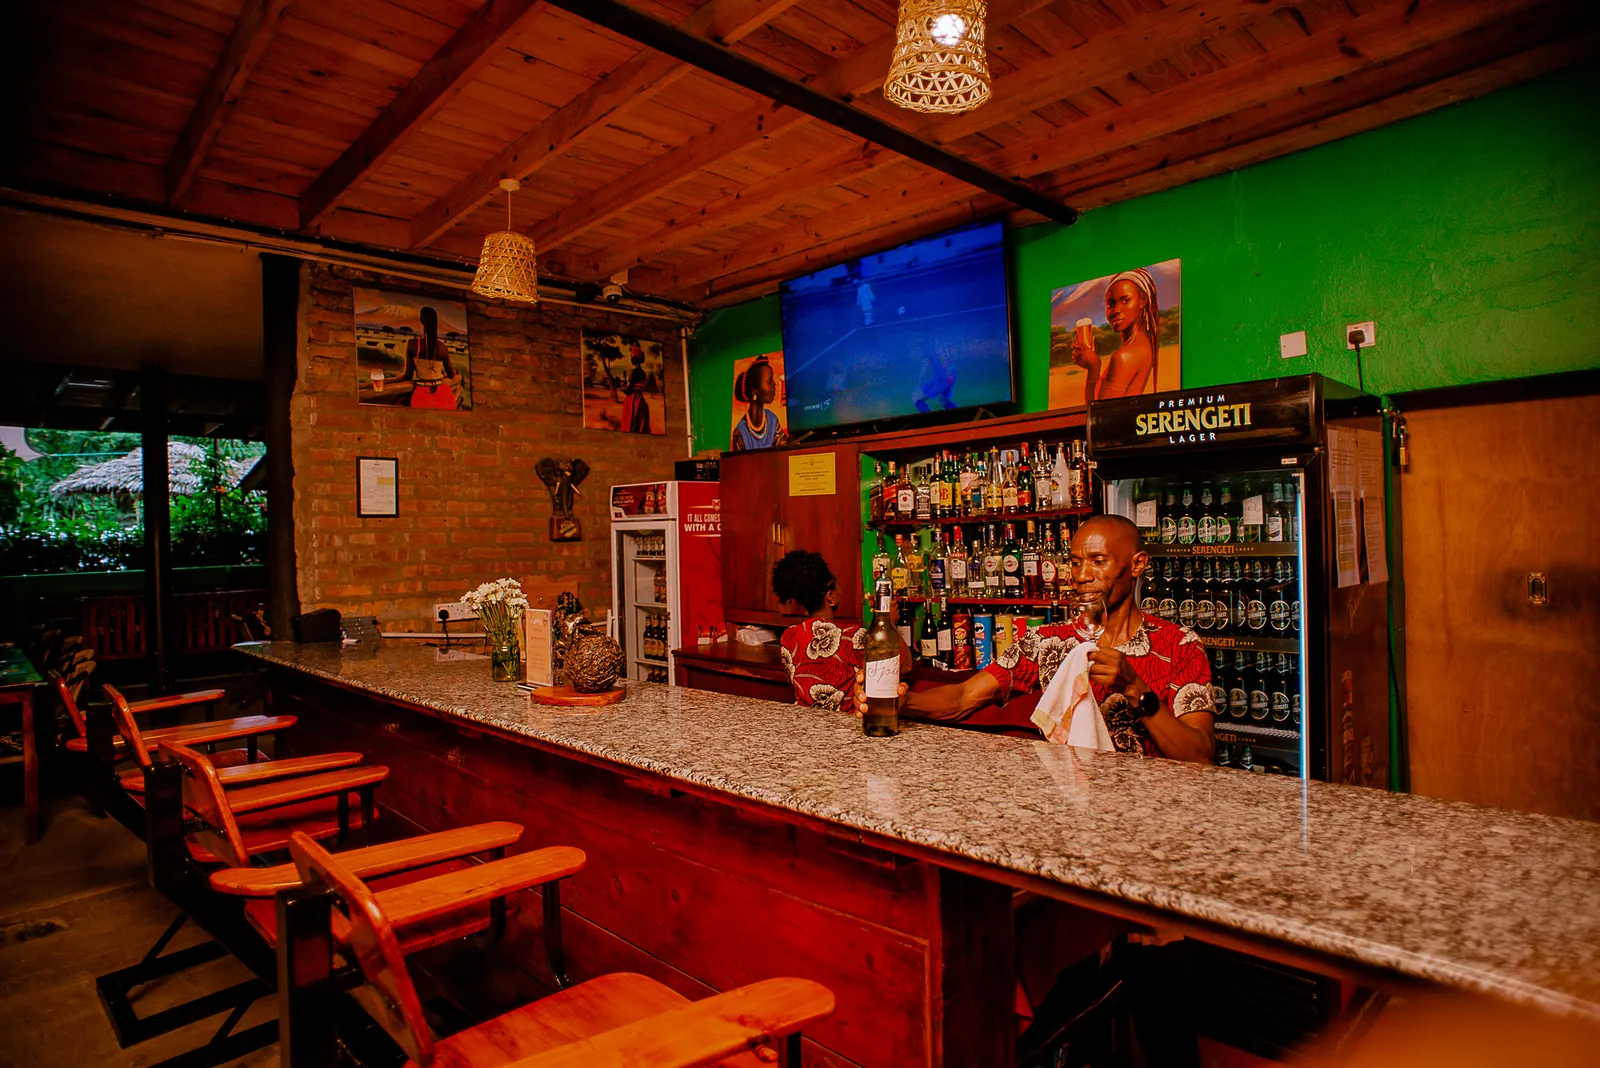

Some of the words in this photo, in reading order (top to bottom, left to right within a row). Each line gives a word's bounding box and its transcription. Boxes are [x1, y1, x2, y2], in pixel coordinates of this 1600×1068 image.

[1158, 395, 1225, 409] PREMIUM
[1135, 402, 1252, 436] SERENGETI
[1169, 432, 1217, 444] LAGER
[687, 514, 693, 523] IT
[694, 514, 703, 523] ALL
[684, 524, 706, 532] WITH
[708, 523, 715, 531] A
[1192, 545, 1235, 554] SERENGETI
[1201, 636, 1235, 647] RENGETI
